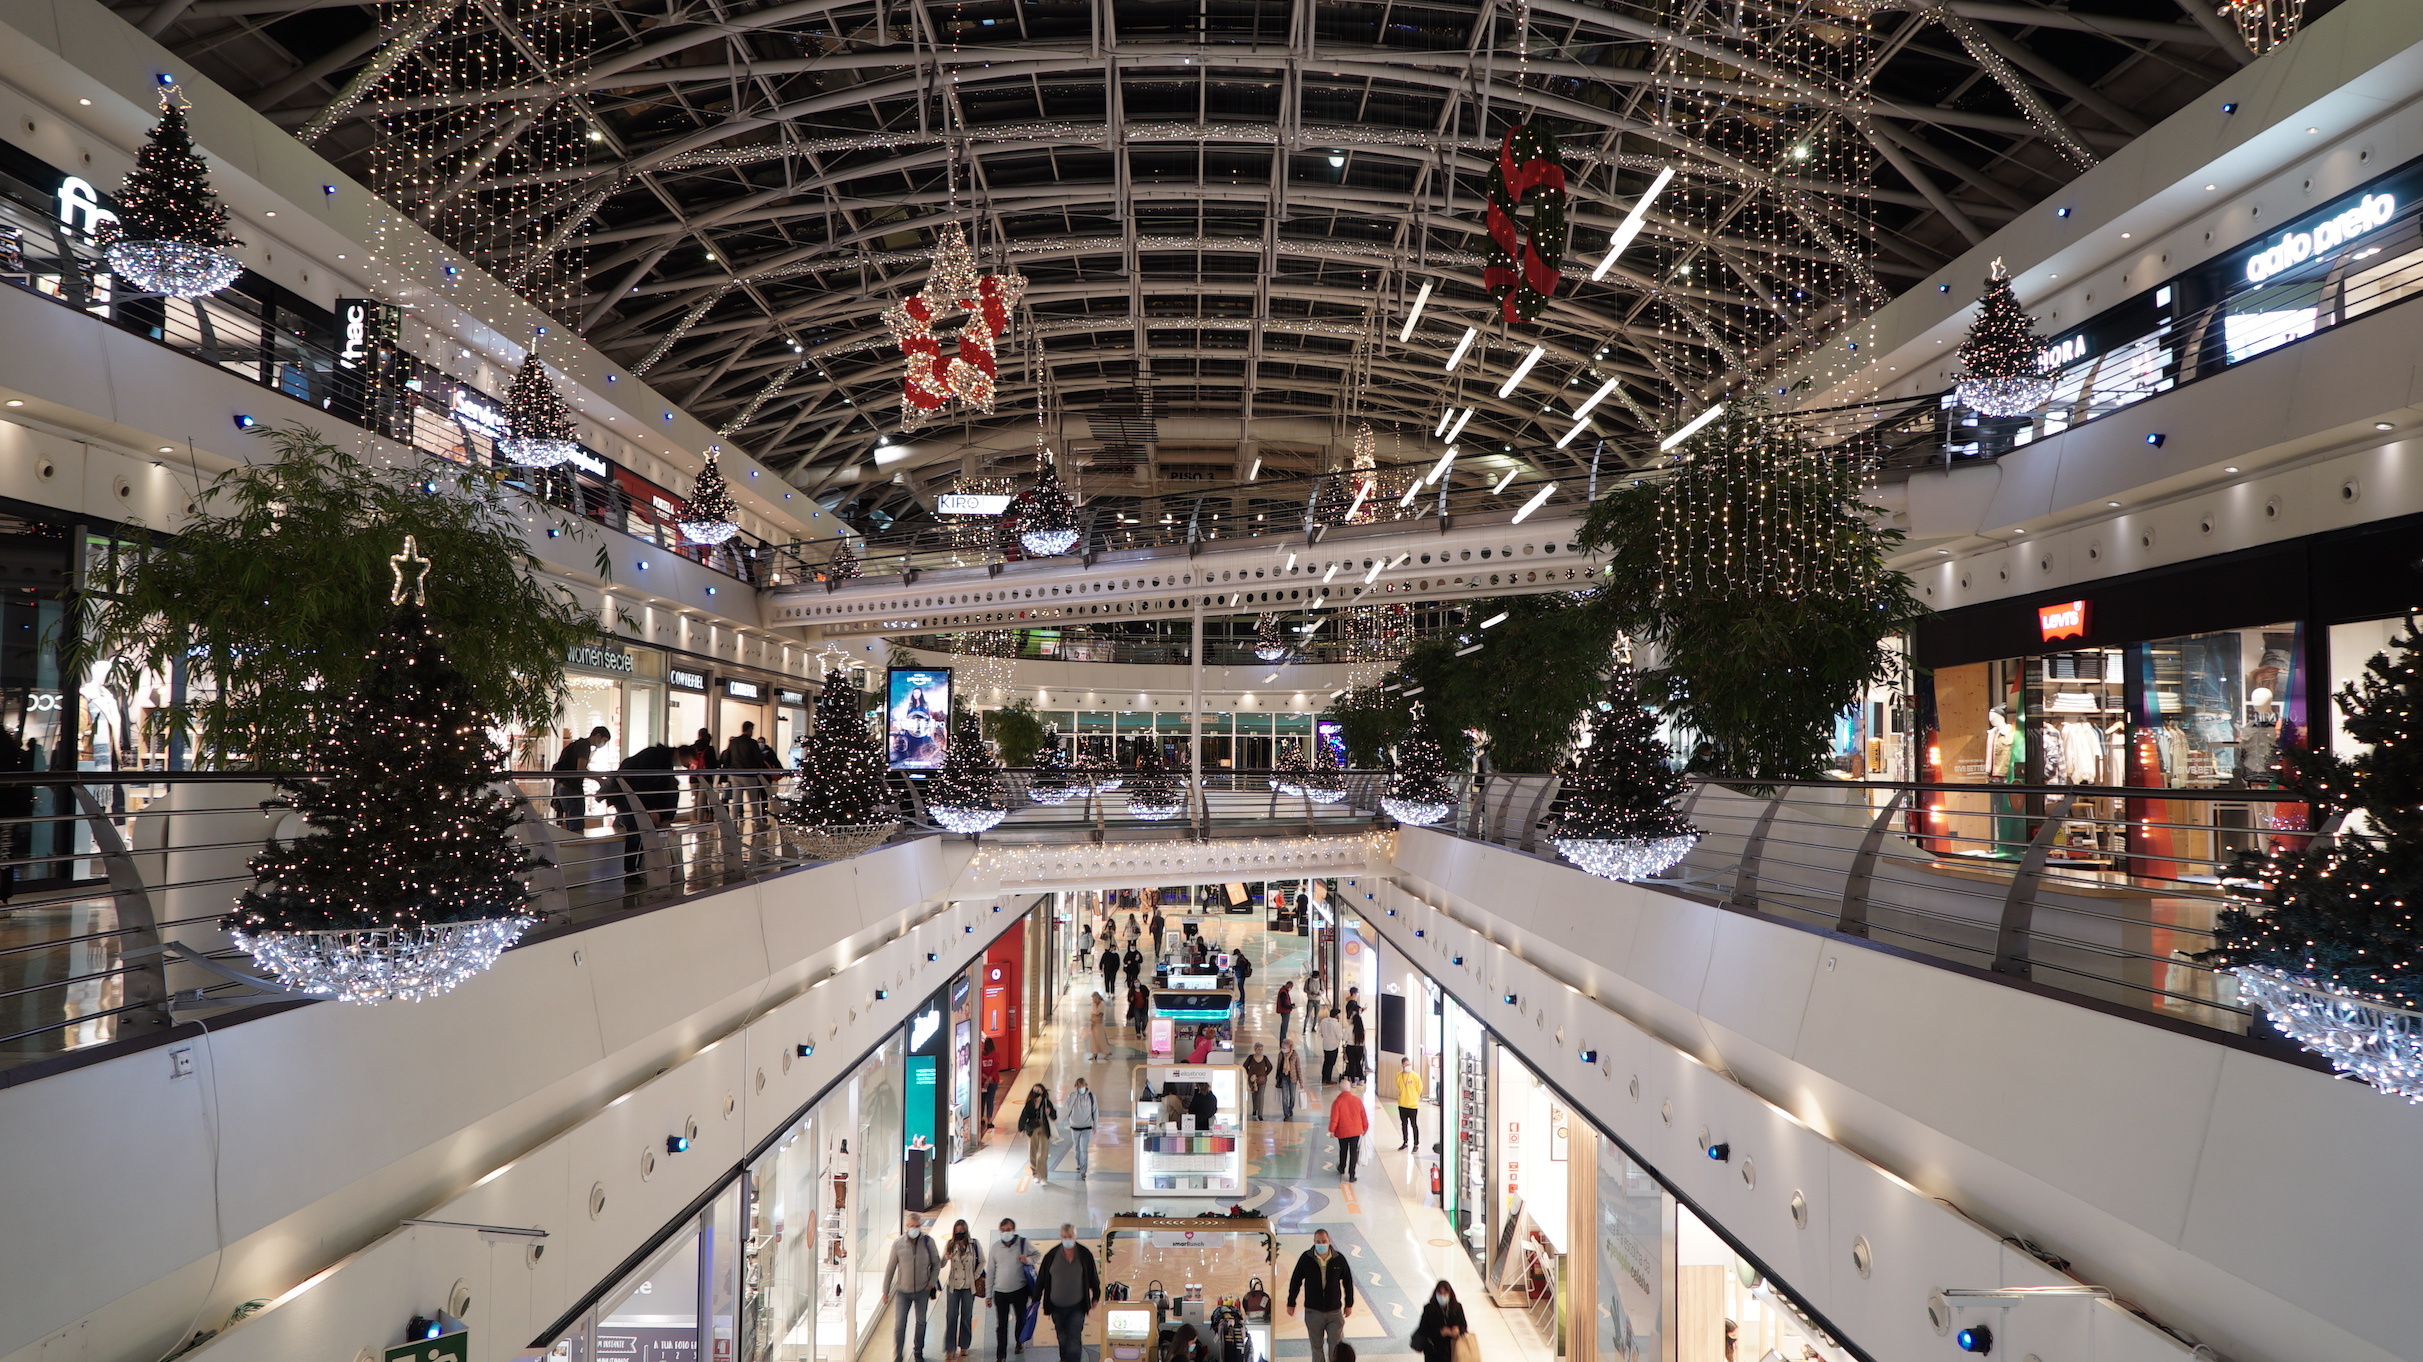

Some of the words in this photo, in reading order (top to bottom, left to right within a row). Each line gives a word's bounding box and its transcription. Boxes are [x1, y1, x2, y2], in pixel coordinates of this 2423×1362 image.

[2247, 232, 2312, 282] gato
[2313, 193, 2395, 255] preto
[1171, 472, 1202, 482] PISO
[940, 497, 979, 509] KIRO
[670, 669, 704, 690] CORTEFIEL
[653, 1340, 659, 1350] A
[661, 1340, 673, 1350] TUA
[675, 1340, 690, 1350] FOTO
[675, 1351, 680, 1360] 2
